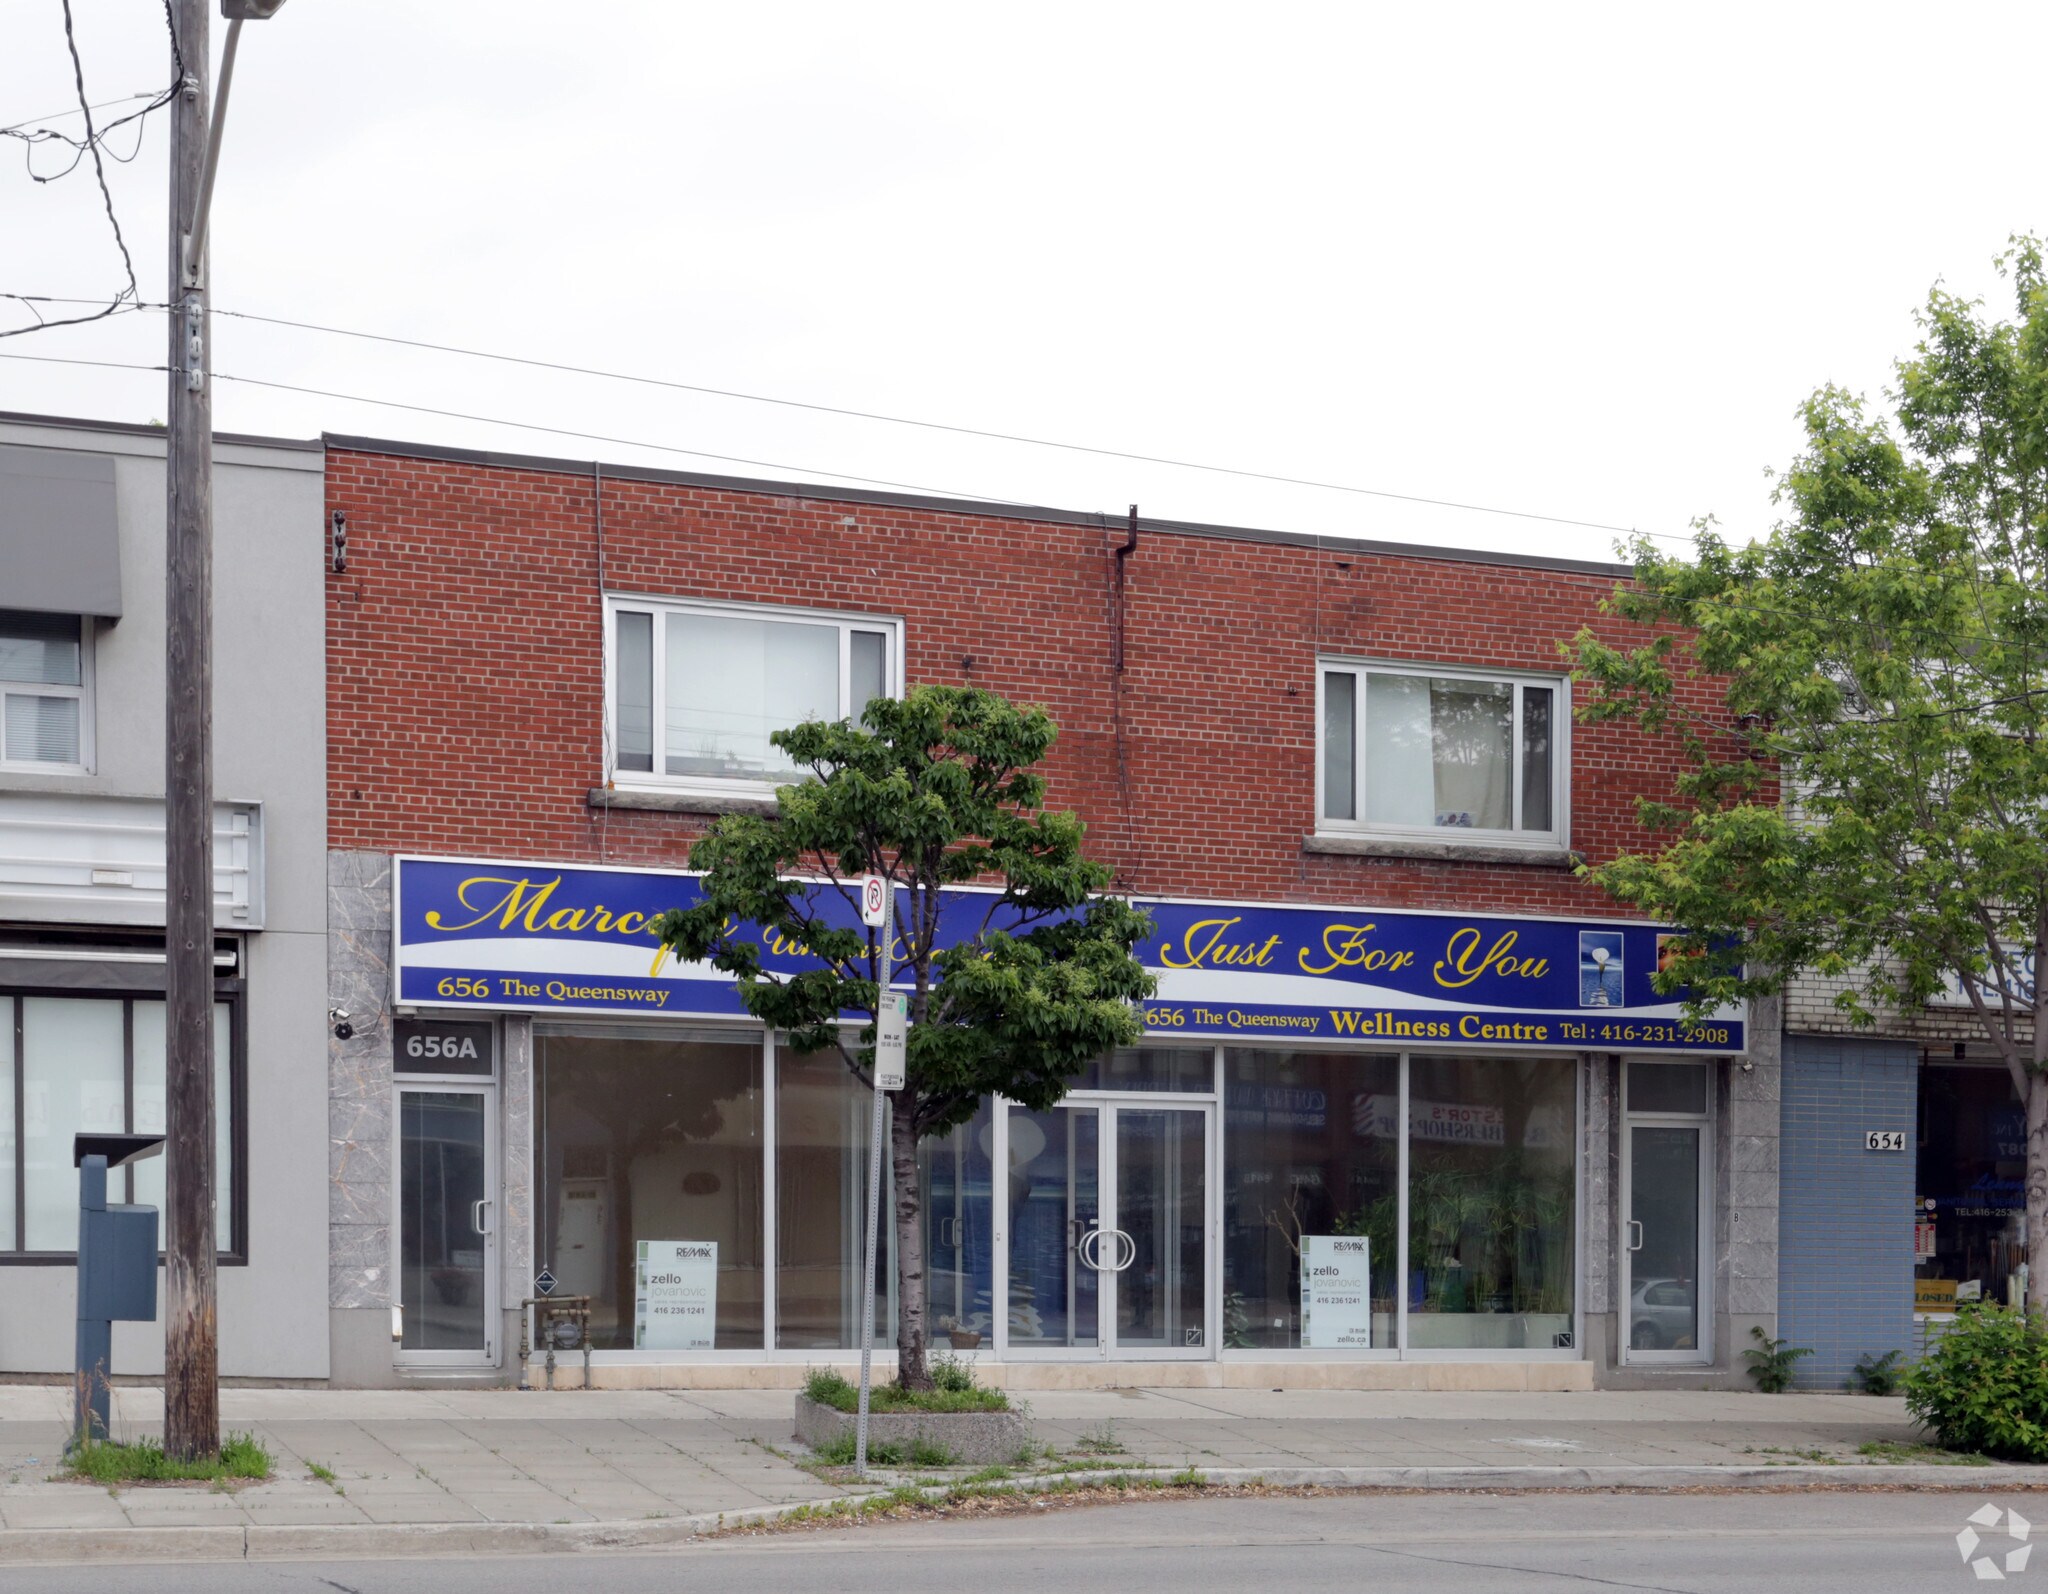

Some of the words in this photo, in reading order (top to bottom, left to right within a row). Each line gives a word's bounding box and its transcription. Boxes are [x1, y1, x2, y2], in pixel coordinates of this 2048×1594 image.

[1160, 916, 1283, 969] Just
[1298, 923, 1413, 975] For
[1433, 927, 1549, 988] You
[437, 976, 489, 998] 656
[500, 978, 540, 997] The
[546, 980, 670, 1007] Queensway
[1146, 1007, 1185, 1027] 656
[1192, 1008, 1223, 1026] The
[1227, 1009, 1320, 1033] Queensway
[1329, 1010, 1450, 1037] Wellness
[1458, 1015, 1548, 1040] Centre
[1600, 1024, 1729, 1044] 416-231-2908
[406, 1035, 478, 1059] 656A
[1870, 1132, 1903, 1149] 654
[1333, 1242, 1364, 1251] RE/MAX
[676, 1247, 711, 1258] RE/MAX
[1313, 1266, 1339, 1276] zello
[651, 1273, 681, 1284] zello
[1314, 1279, 1360, 1289] jovanovic
[651, 1286, 706, 1298] jovanovic
[1337, 1335, 1366, 1344] zello.ca
